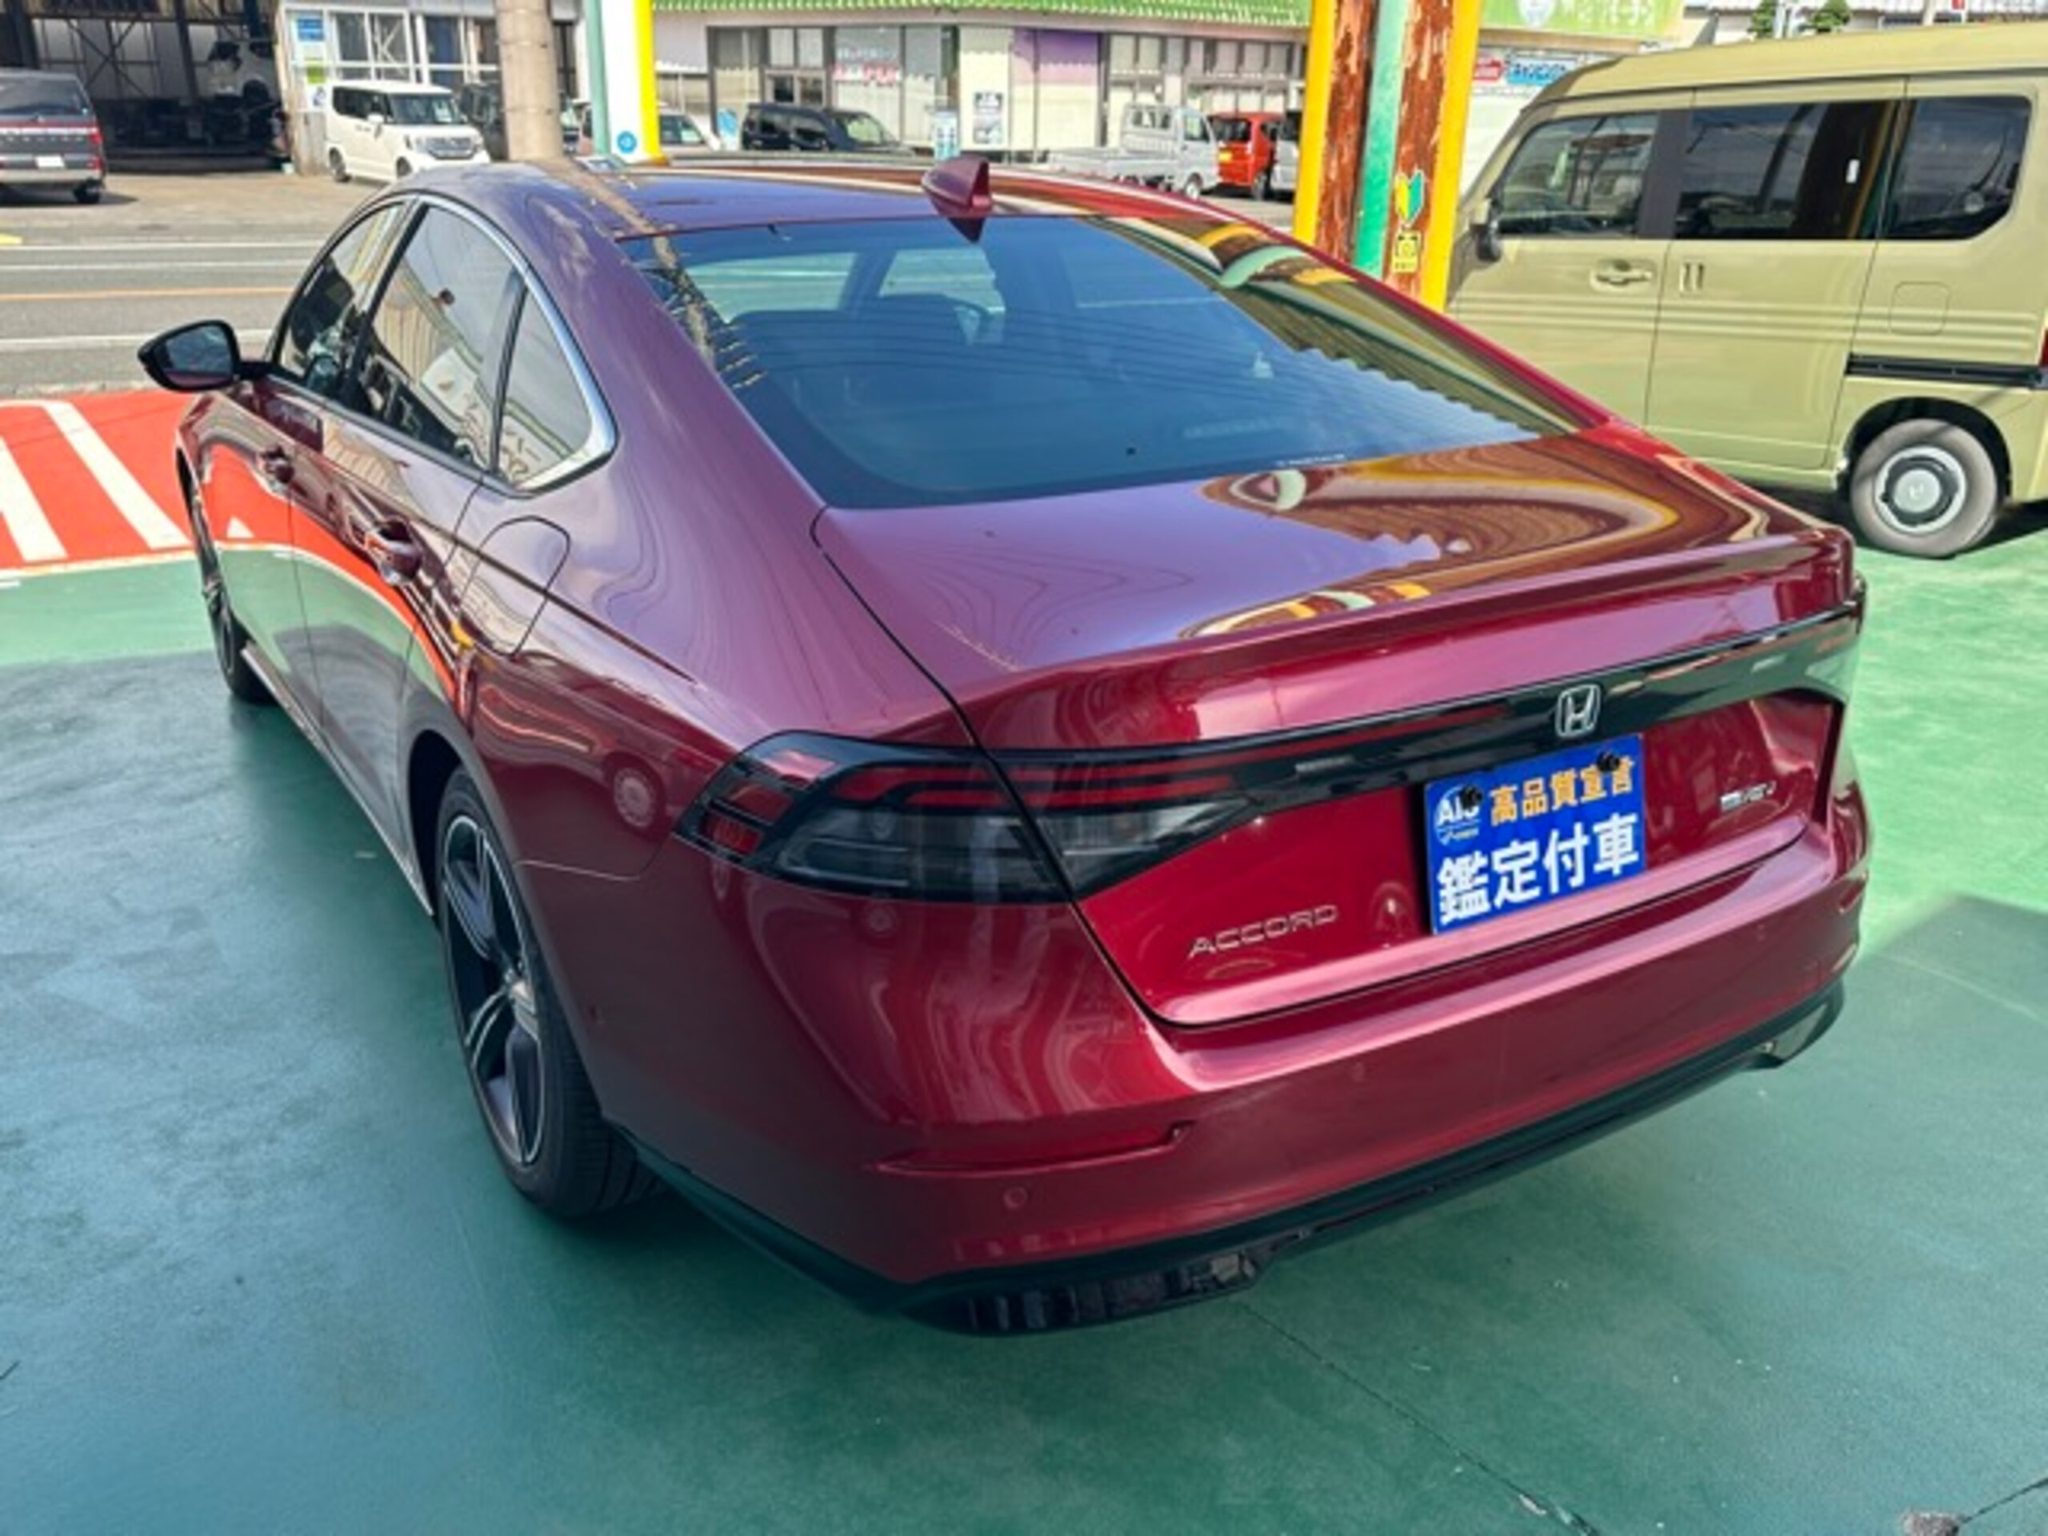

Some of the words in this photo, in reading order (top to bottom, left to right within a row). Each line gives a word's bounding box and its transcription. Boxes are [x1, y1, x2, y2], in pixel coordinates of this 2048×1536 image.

[1437, 812, 1640, 926] 鑑定付車
[1188, 904, 1339, 959] ACCORD
